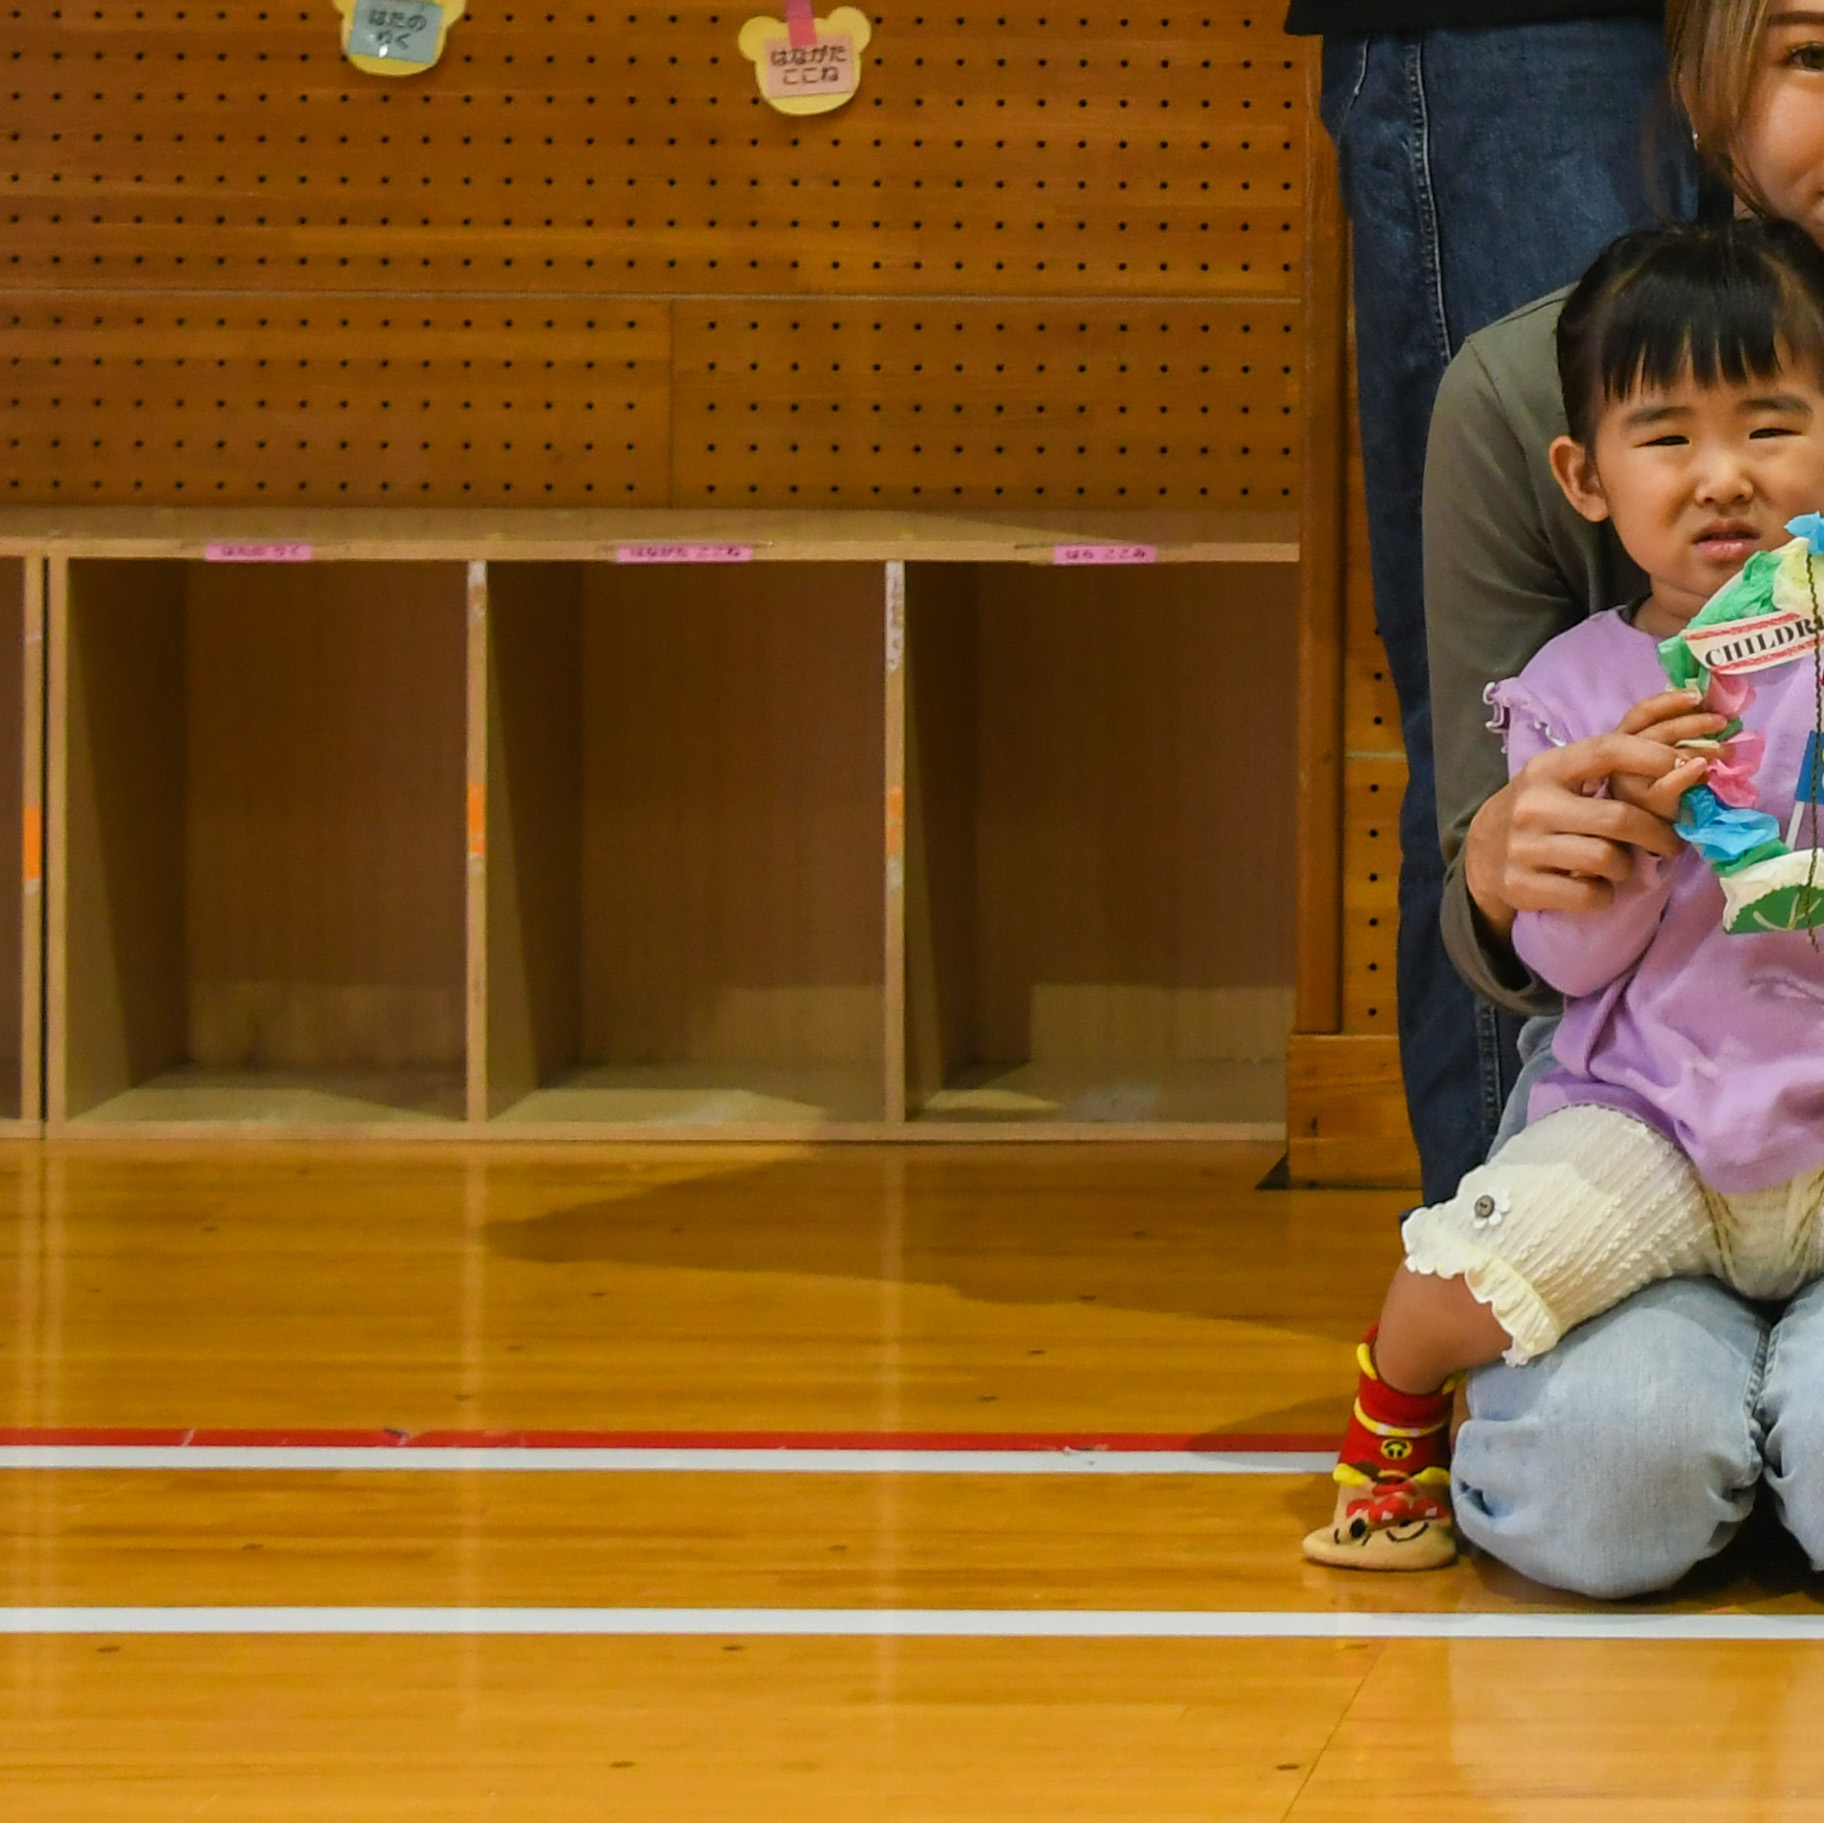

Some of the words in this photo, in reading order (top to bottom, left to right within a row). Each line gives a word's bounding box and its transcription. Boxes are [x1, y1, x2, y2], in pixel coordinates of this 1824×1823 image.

[770, 44, 847, 67] はながた
[783, 66, 839, 85] ここね
